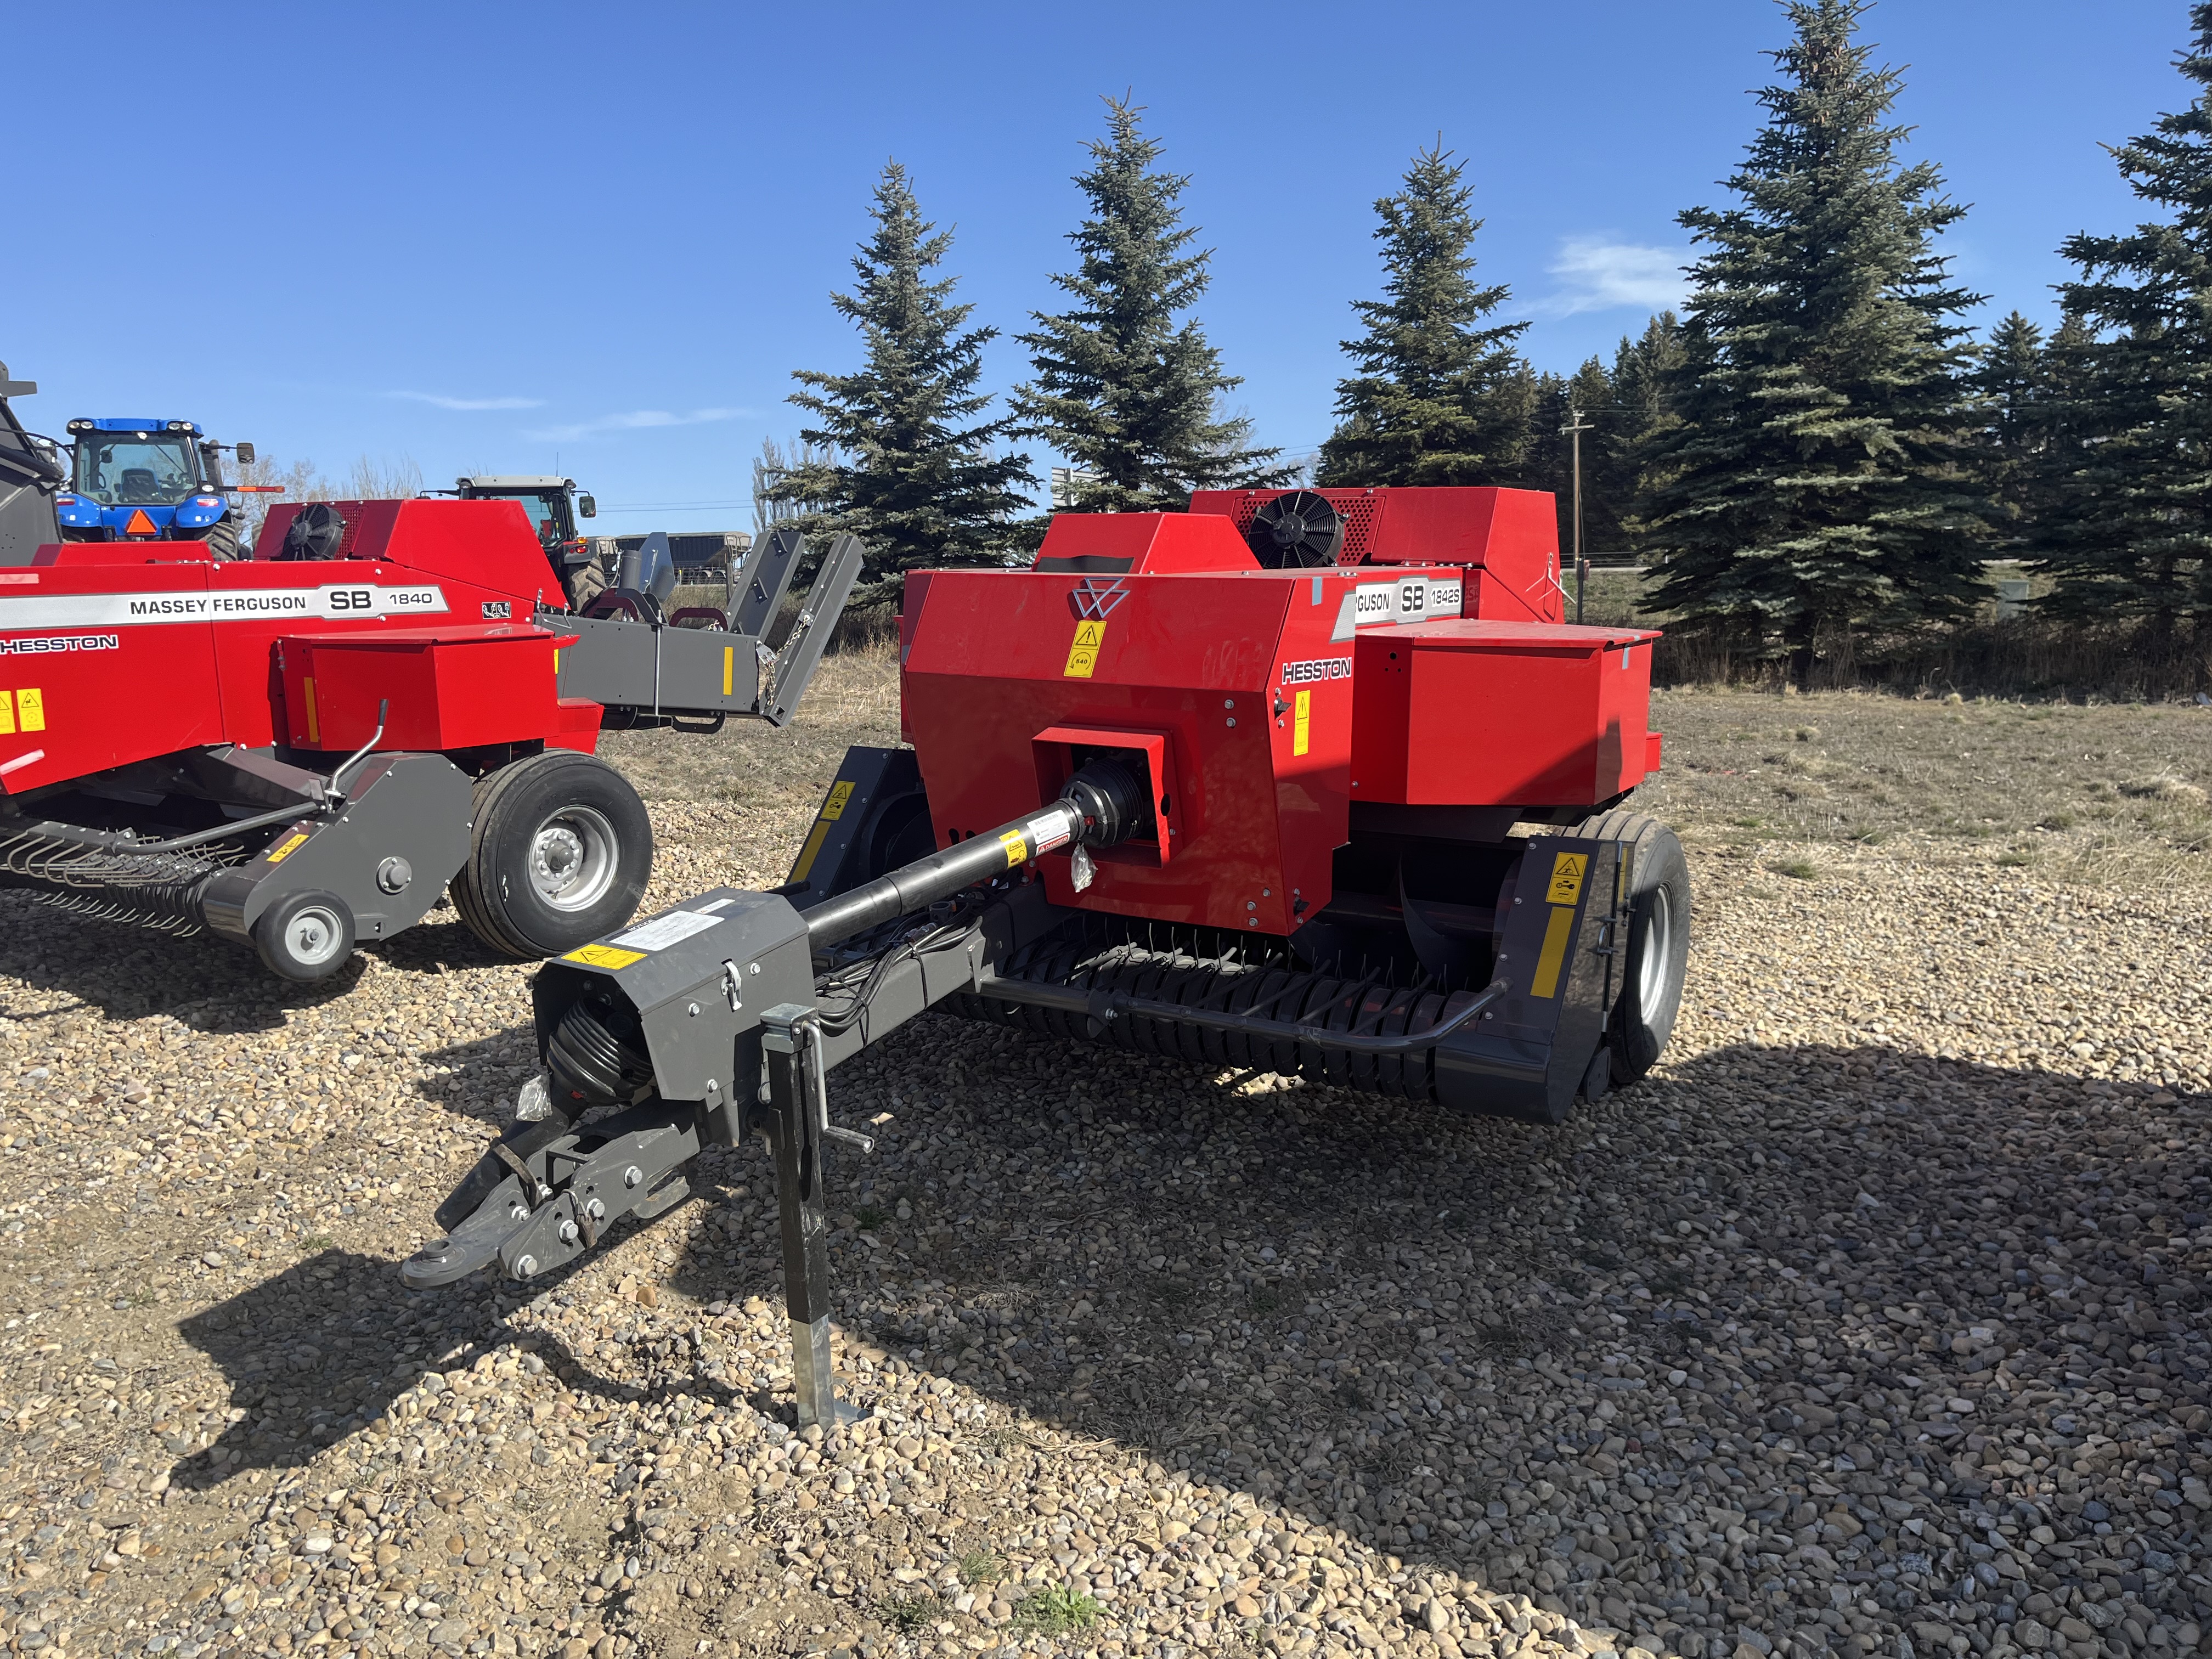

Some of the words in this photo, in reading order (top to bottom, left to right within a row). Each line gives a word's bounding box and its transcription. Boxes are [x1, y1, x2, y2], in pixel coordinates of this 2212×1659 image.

[131, 599, 207, 614] MASSEY
[213, 596, 306, 611] FERGUSON
[329, 590, 373, 610] SB
[389, 593, 433, 605] 1840
[1355, 593, 1390, 612] GUSON
[1401, 585, 1425, 612] SB
[1431, 588, 1459, 605] 1842S
[0, 635, 118, 653] HESSTON
[1283, 658, 1352, 683] HESSTON
[1046, 837, 1068, 850] DANGER
